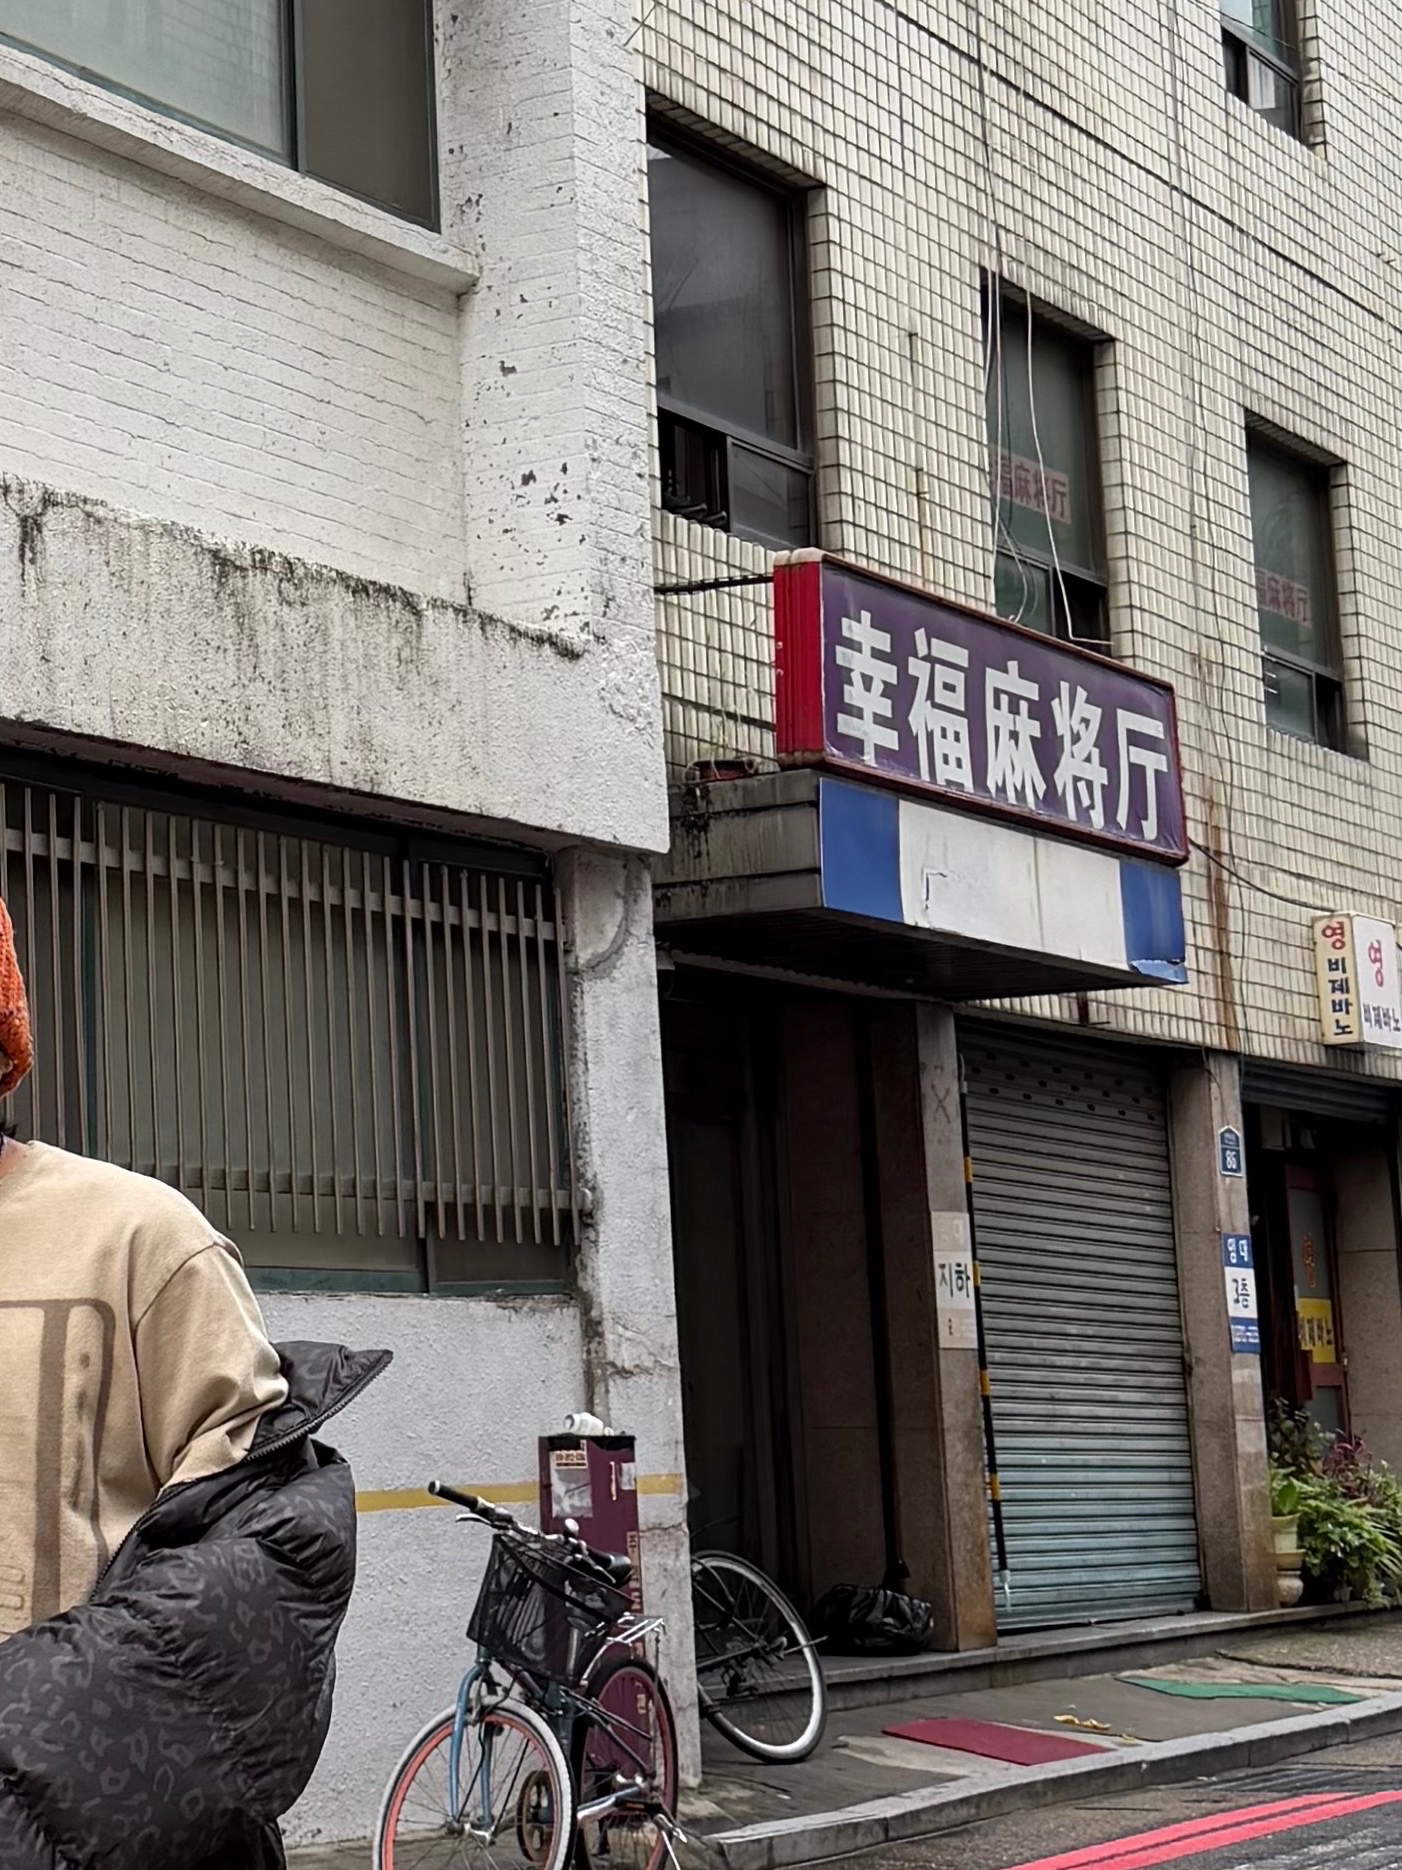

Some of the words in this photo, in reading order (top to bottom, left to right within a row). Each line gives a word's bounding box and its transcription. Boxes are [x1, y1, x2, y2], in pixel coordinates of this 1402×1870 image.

[835, 610, 1169, 842] 幸福麻将厅
[1327, 957, 1353, 1036] 비제바노
[1363, 1003, 1402, 1032] 비제바노
[1227, 1238, 1248, 1263] 임대
[938, 1262, 971, 1299] 지하
